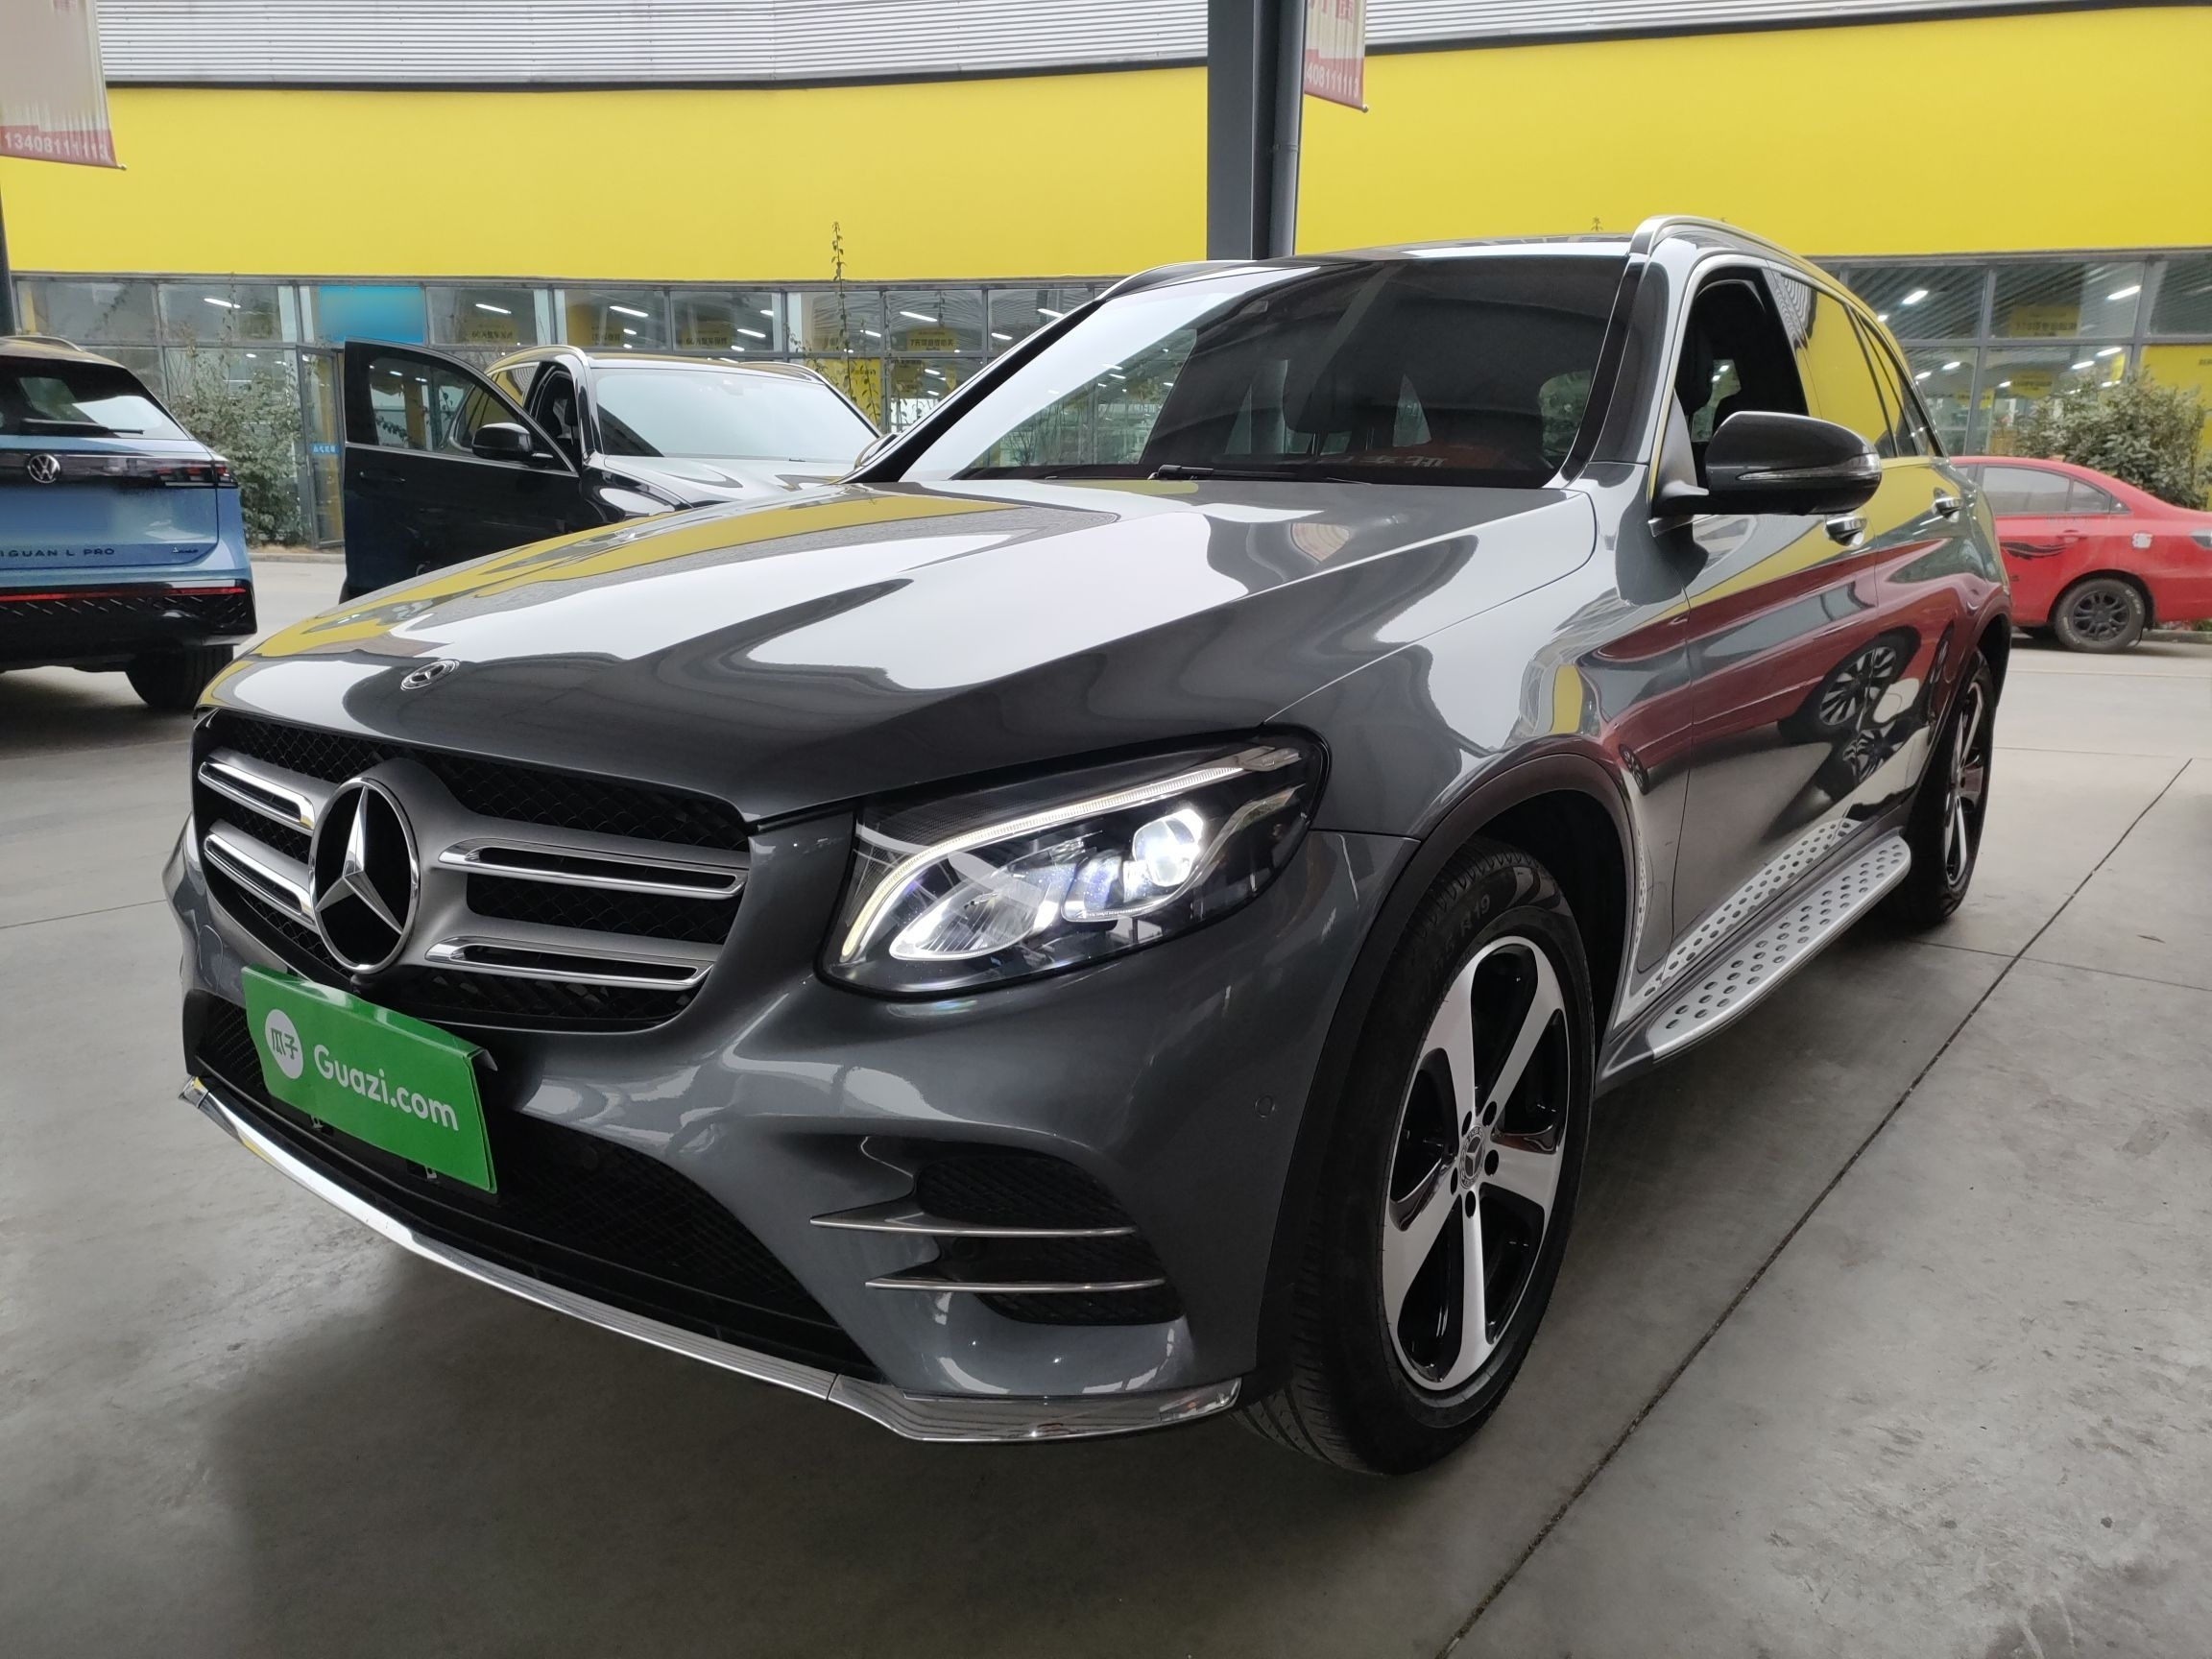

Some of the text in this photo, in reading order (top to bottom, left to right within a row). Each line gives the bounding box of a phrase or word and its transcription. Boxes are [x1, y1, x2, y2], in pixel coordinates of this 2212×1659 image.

[0, 549, 58, 558] IGUAN
[65, 548, 75, 557] L
[270, 1027, 299, 1060] 瓜子
[313, 1044, 459, 1132] Guazi.com
